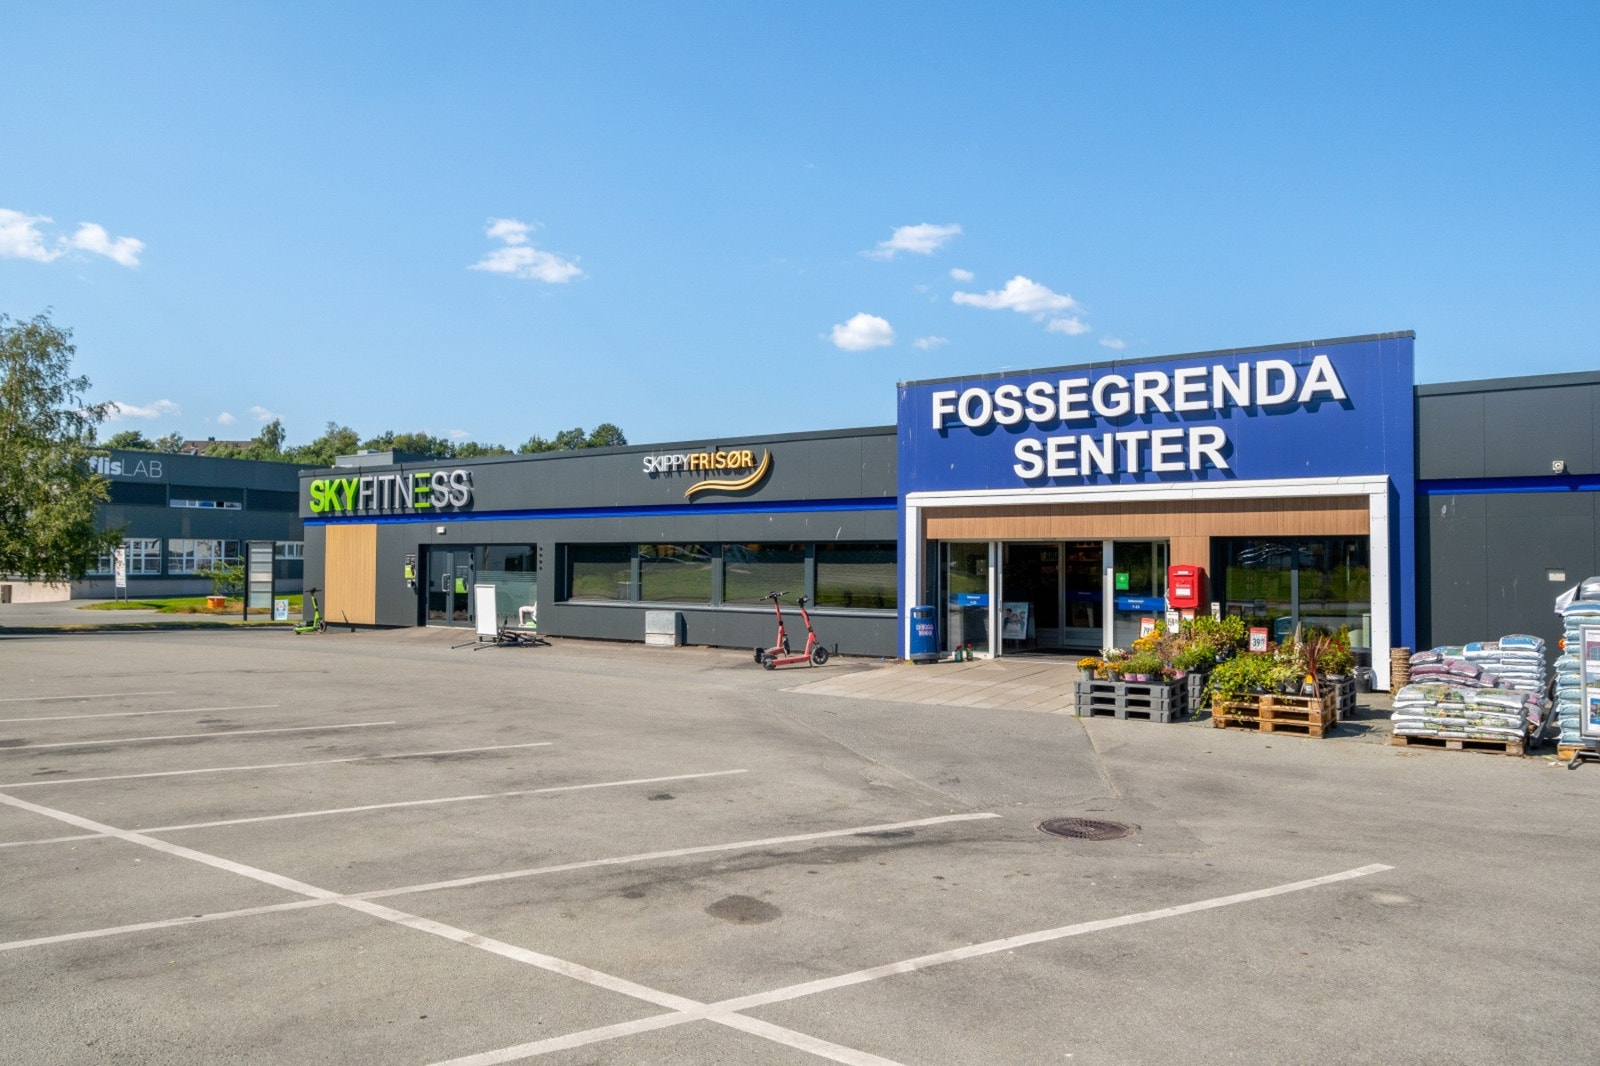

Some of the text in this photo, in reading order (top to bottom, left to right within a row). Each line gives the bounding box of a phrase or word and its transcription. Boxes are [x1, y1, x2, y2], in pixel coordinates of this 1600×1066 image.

[931, 355, 1347, 430] FOSSEGRENDA
[1013, 425, 1229, 479] SENTER
[309, 469, 471, 513] SKYFITNESS
